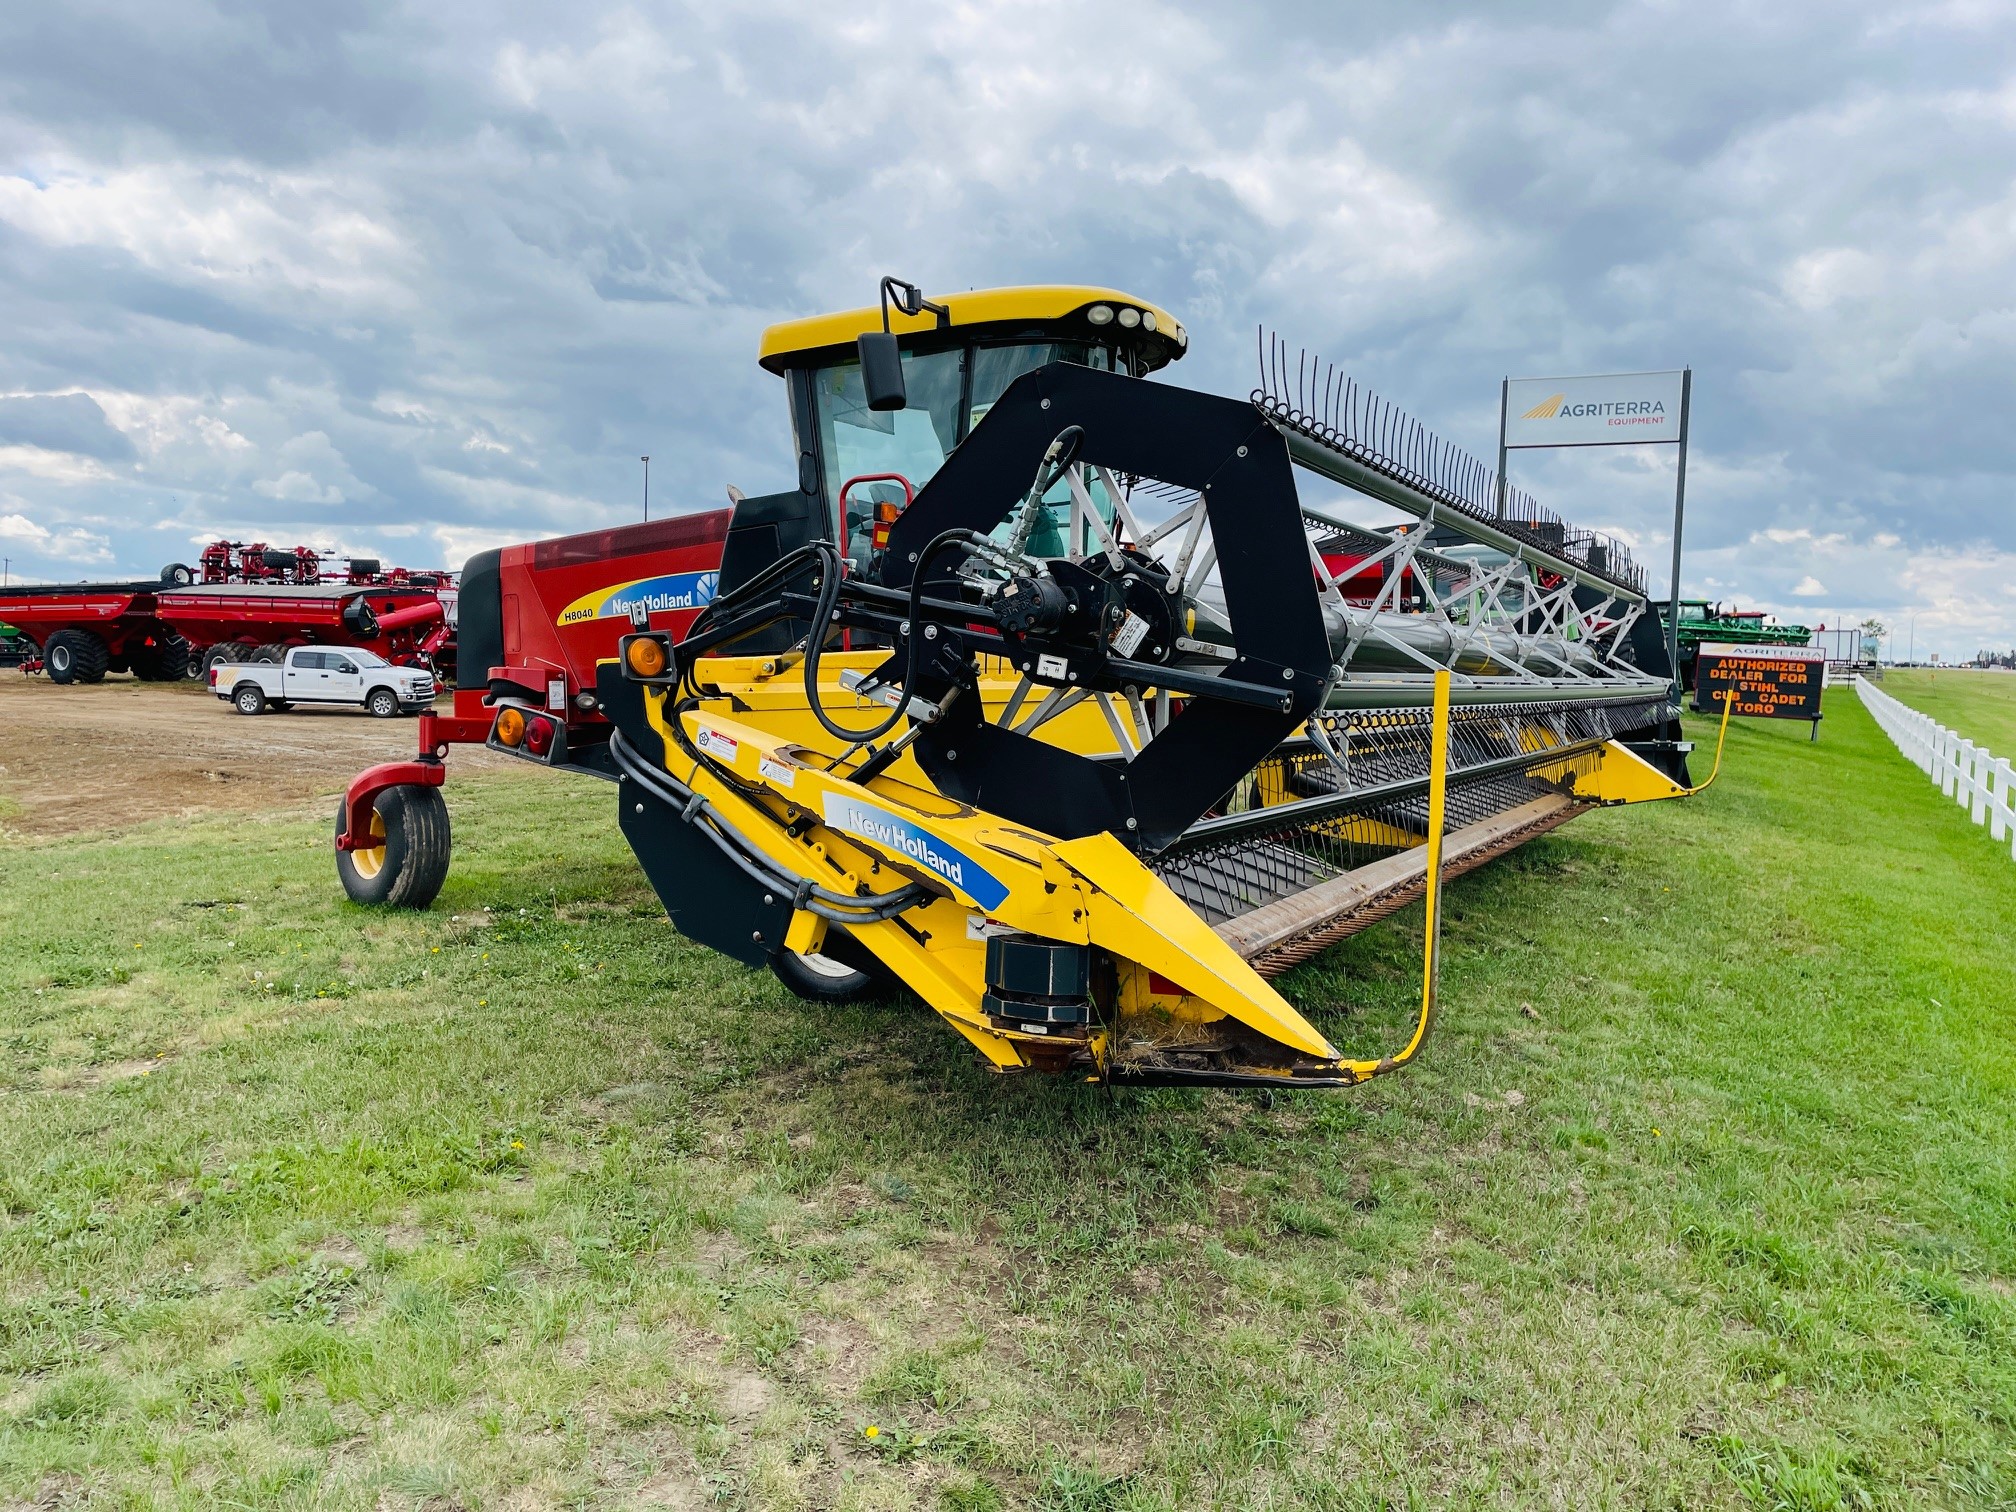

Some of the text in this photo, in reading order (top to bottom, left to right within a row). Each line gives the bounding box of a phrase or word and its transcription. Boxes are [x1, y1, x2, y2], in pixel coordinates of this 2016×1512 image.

[1559, 400, 1665, 418] AGRITERRA
[1608, 416, 1666, 426] EQUIPMENT
[643, 591, 692, 610] Holland
[564, 608, 593, 622] H8040
[1732, 647, 1822, 658] AGRITERRA
[1718, 659, 1806, 673] AUTHORIZED
[1710, 669, 1808, 684] DEALER FOR
[1739, 681, 1779, 693] STIHL
[1759, 693, 1806, 705] CADET
[1735, 702, 1775, 714] TORO
[848, 808, 964, 886] New Holland
